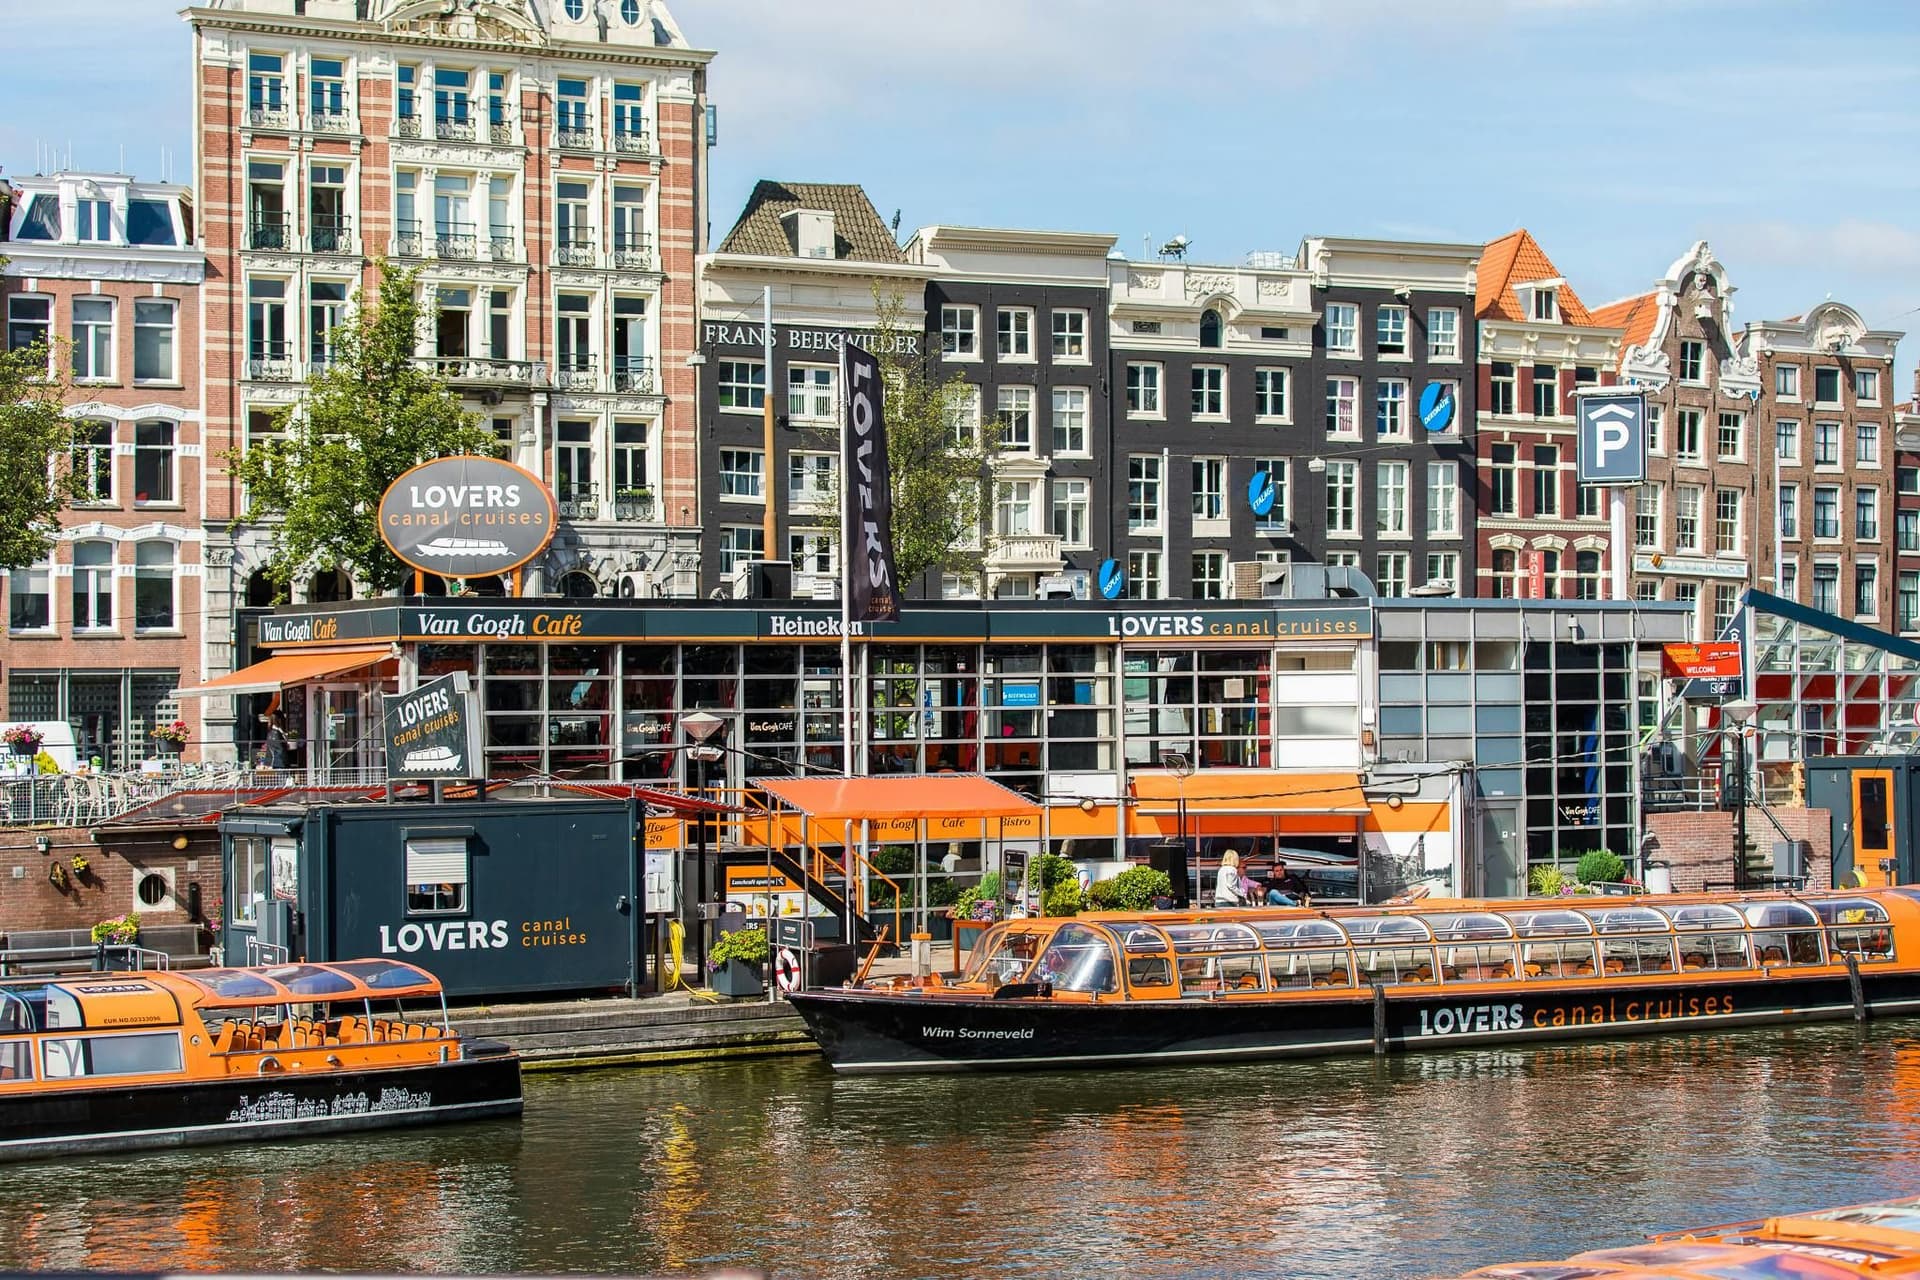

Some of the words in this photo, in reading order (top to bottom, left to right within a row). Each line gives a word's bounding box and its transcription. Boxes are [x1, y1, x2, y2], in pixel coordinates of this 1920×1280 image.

[704, 324, 777, 347] FRANS
[1596, 421, 1630, 468] P
[410, 485, 521, 508] LOVERS
[1253, 483, 1274, 510] ETALAGE
[389, 511, 449, 526] canal
[460, 509, 543, 525] cruises
[1529, 551, 1539, 598] HOTE
[264, 622, 281, 641] Van
[284, 620, 310, 643] Gogh
[313, 618, 337, 640] Café
[418, 613, 459, 635] Van
[467, 614, 525, 640] Gogh
[532, 613, 582, 635] Café
[1108, 615, 1204, 636] LOVERS
[1210, 618, 1270, 636] canal
[1277, 617, 1358, 635] cruises
[1686, 665, 1716, 674] WELCOME
[397, 686, 450, 728] LOVERS
[394, 725, 422, 747] canal
[424, 708, 459, 737] cruises
[639, 723, 657, 734] Gogh
[750, 721, 761, 731] Van
[762, 721, 778, 732] Gogh
[1575, 806, 1588, 816] Gogh
[647, 822, 666, 834] ffee
[1001, 817, 1031, 828] Bistro
[522, 916, 571, 933] canal
[379, 919, 509, 953] LOVERS
[522, 931, 587, 947] cruises
[1420, 1002, 1524, 1036] LOVERS
[1533, 997, 1616, 1028] canal
[1626, 991, 1735, 1021] cruises
[922, 1026, 955, 1039] Wim
[958, 1027, 1035, 1040] Sonneveld
